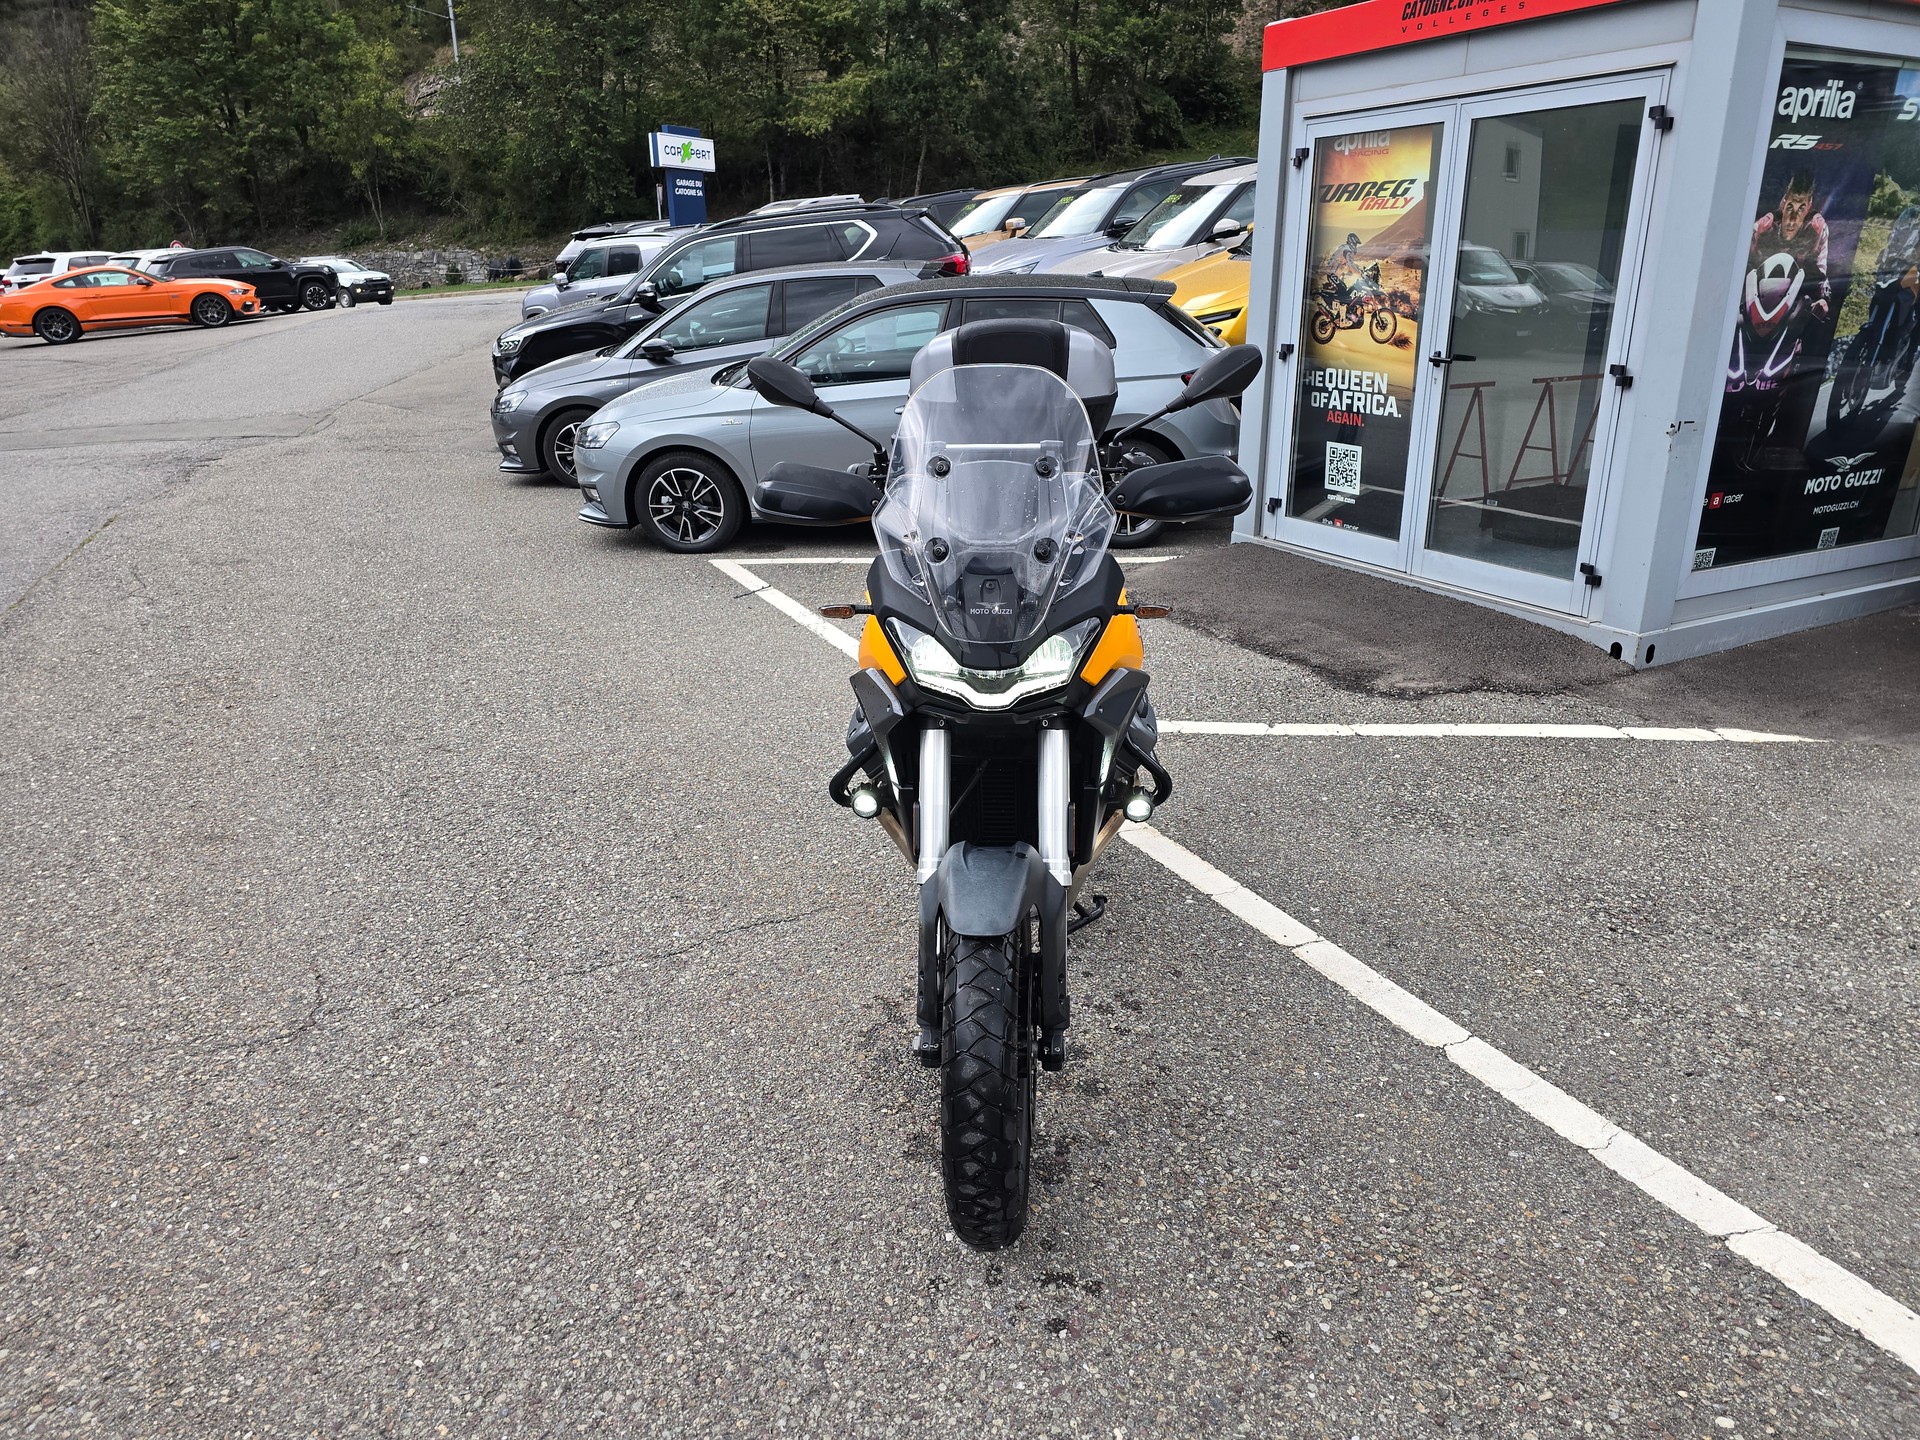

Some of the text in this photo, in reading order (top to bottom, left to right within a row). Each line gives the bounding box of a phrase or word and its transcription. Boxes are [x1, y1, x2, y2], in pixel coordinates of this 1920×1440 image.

[1401, 2, 1526, 33] VOLLEGES
[1778, 79, 1857, 123] aprilia
[1896, 96, 1920, 120] S
[1769, 133, 1823, 150] RS
[1349, 148, 1390, 158] RACING
[696, 189, 703, 197] SA
[1319, 178, 1417, 204] UAREG
[1357, 196, 1415, 211] RALLY
[1304, 367, 1388, 394] HE QUEEN
[1311, 389, 1402, 418] OF AFRICA.
[1326, 409, 1365, 427] AGAIN.
[1804, 468, 1883, 495] MOTO GUZZI
[1723, 493, 1745, 504] racer
[1812, 501, 1859, 514] MOTOGUZZI.CH
